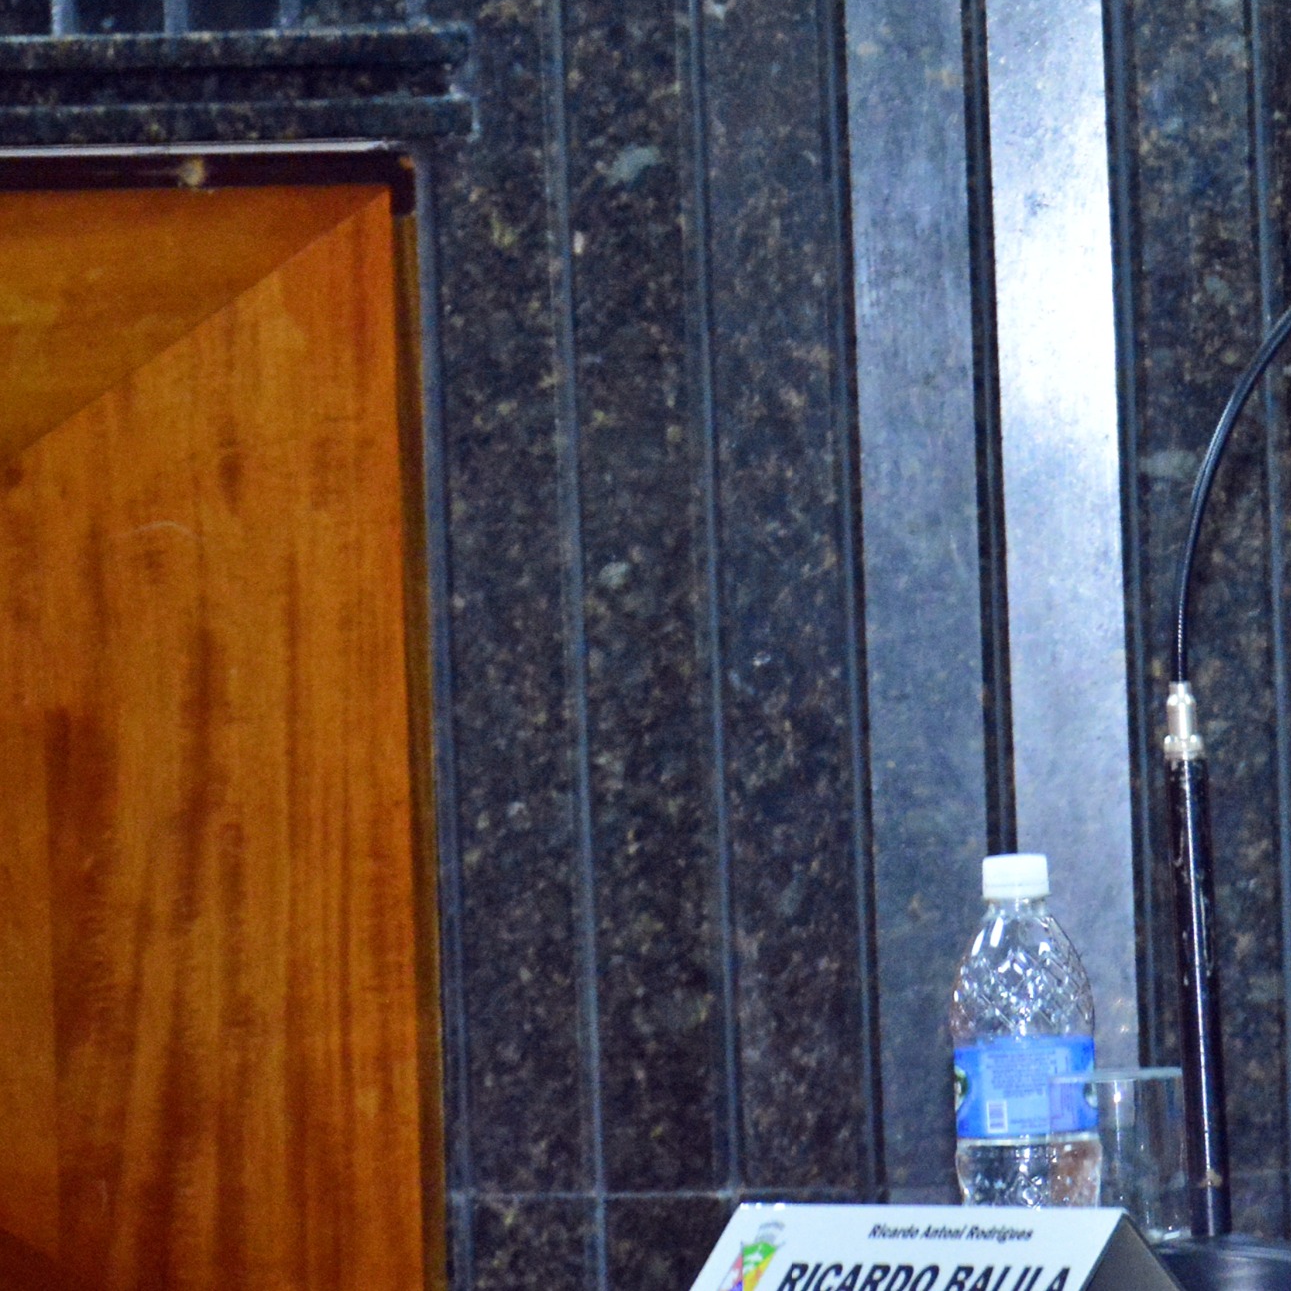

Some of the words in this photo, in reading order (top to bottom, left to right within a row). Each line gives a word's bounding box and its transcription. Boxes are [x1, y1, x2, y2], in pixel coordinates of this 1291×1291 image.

[868, 1223, 919, 1240] Ricardo
[965, 1224, 1034, 1245] Rodrigues
[776, 1262, 940, 1291] RICARDO
